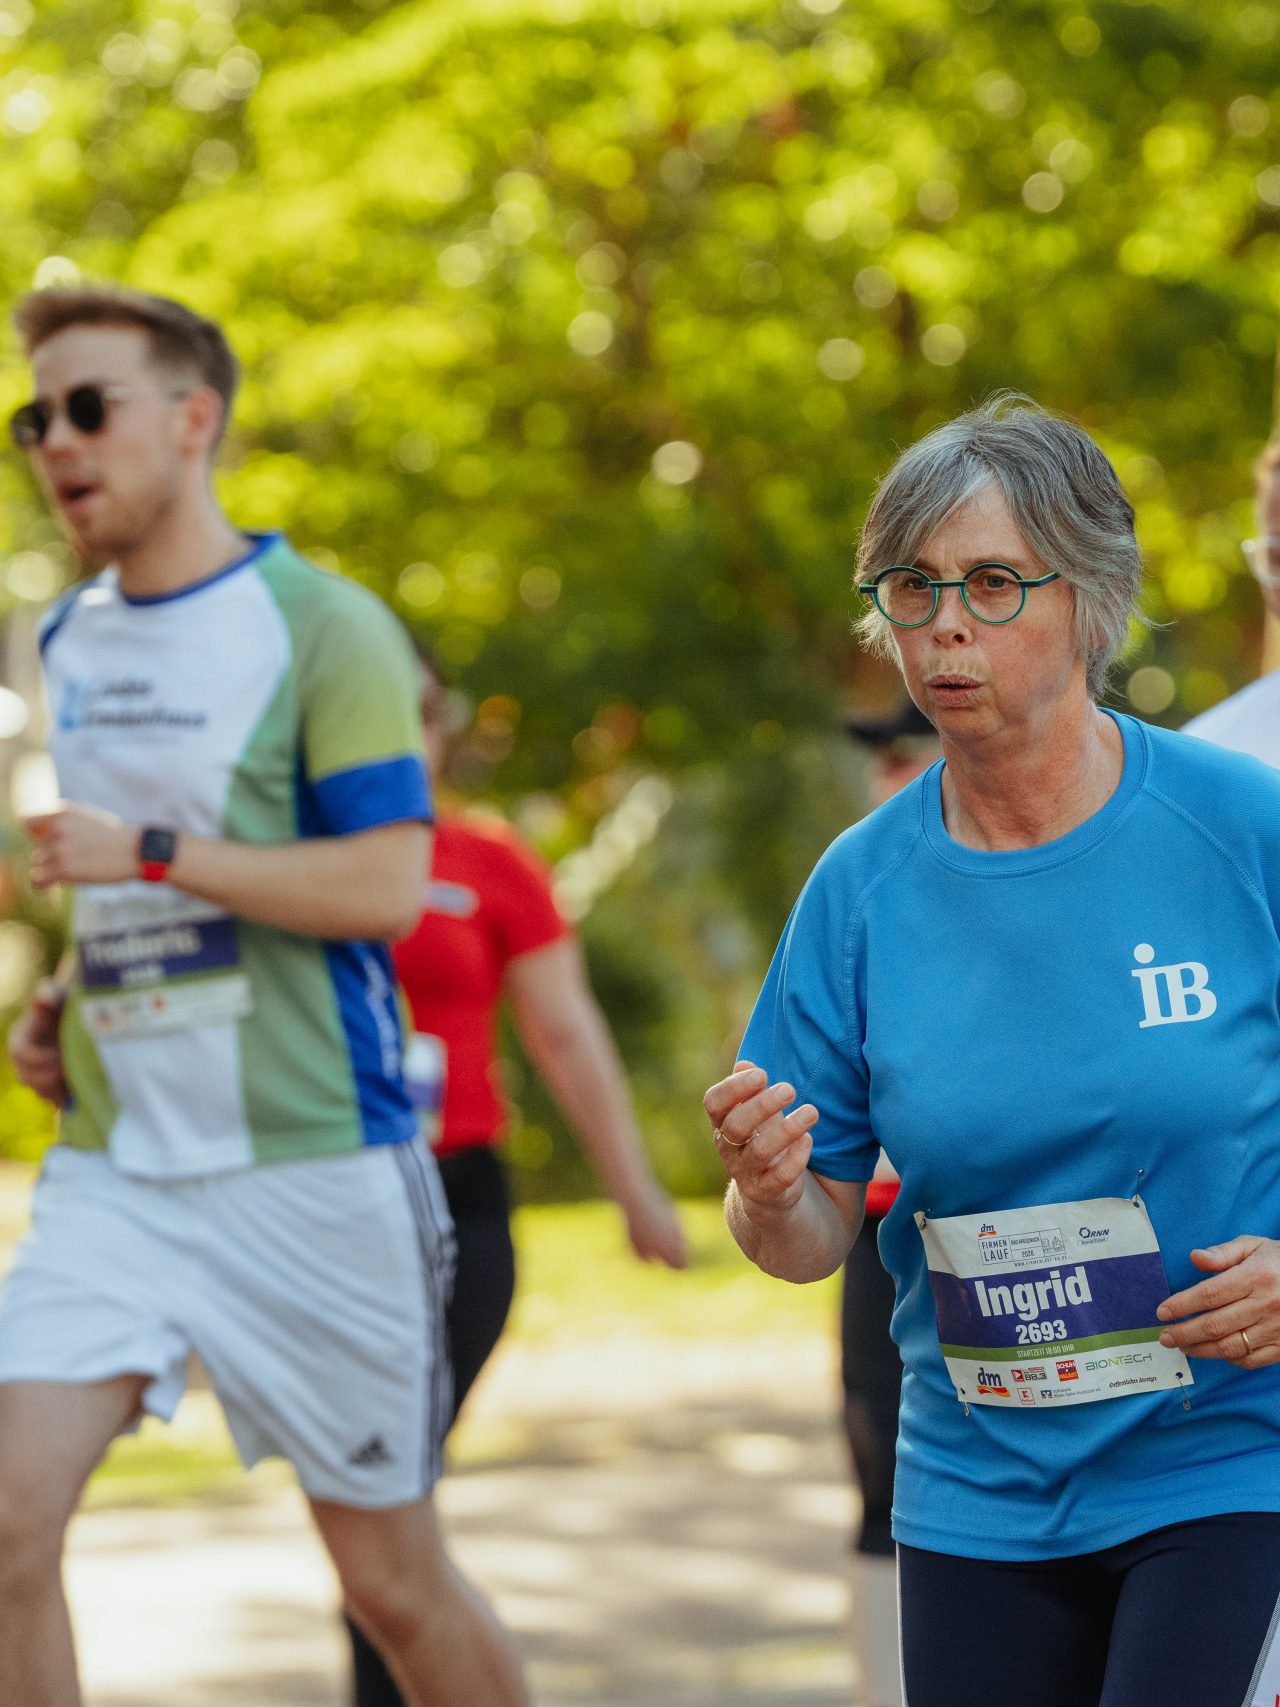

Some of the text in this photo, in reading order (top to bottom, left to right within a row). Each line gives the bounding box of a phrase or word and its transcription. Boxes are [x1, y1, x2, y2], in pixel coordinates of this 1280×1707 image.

[980, 1223, 995, 1233] dm
[981, 1239, 1008, 1250] FIRMEN
[983, 1248, 1009, 1262] LAUF
[974, 1266, 1093, 1321] Ingrid
[1015, 1319, 1068, 1345] 2693
[1016, 1347, 1045, 1359] STARTZEIT
[1085, 1352, 1153, 1371] BIONTECH
[977, 1366, 1002, 1387] dm
[1024, 1372, 1047, 1381] 88.3
